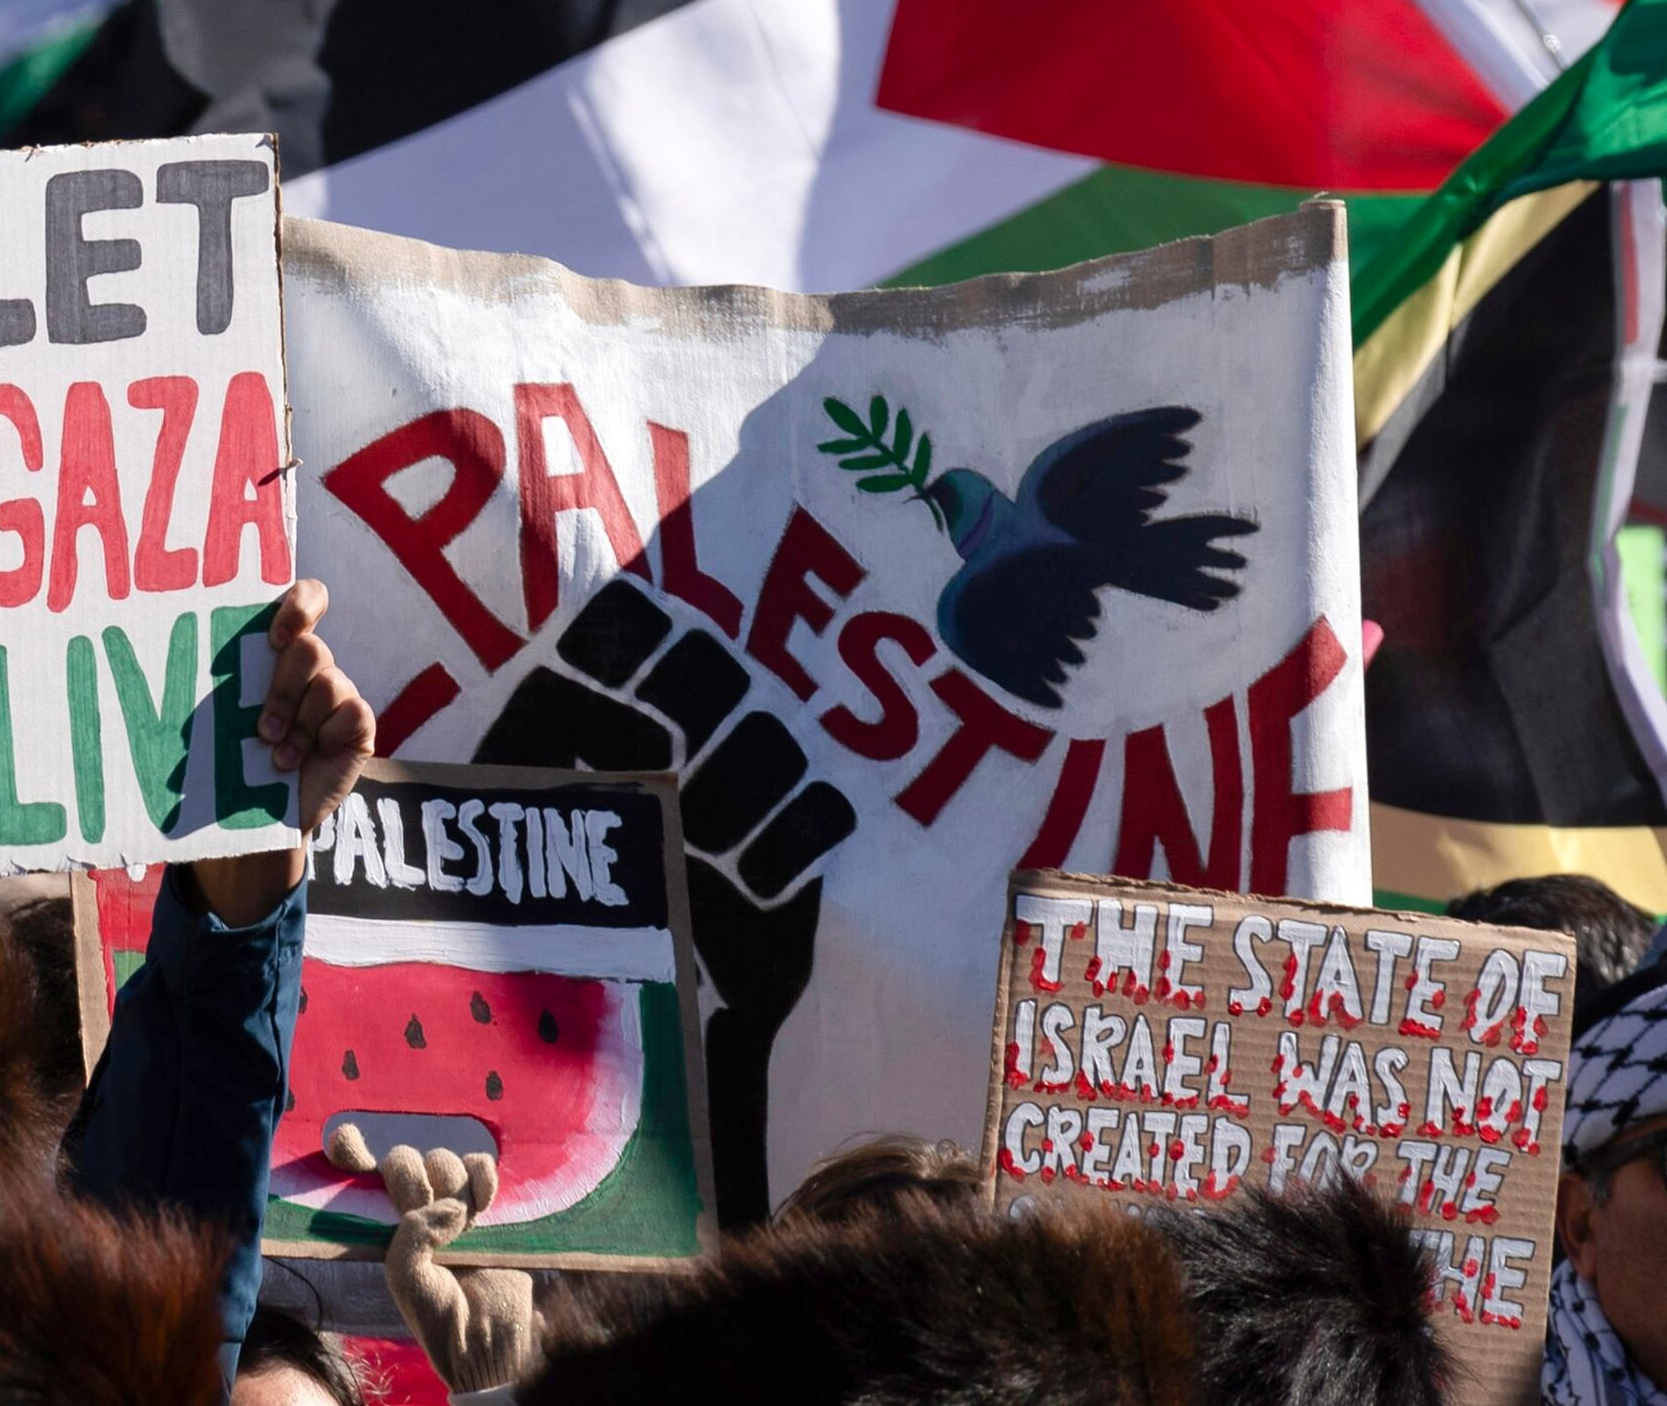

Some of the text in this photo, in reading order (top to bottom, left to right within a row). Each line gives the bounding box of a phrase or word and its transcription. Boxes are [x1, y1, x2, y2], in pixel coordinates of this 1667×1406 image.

[323, 382, 1355, 899] PALESTINE
[1016, 896, 1568, 1055] THE STATE OF
[1006, 999, 1563, 1156] ISRAEL WAS NOT
[1001, 1102, 1252, 1198] CREATED
[1396, 1139, 1513, 1225] THE
